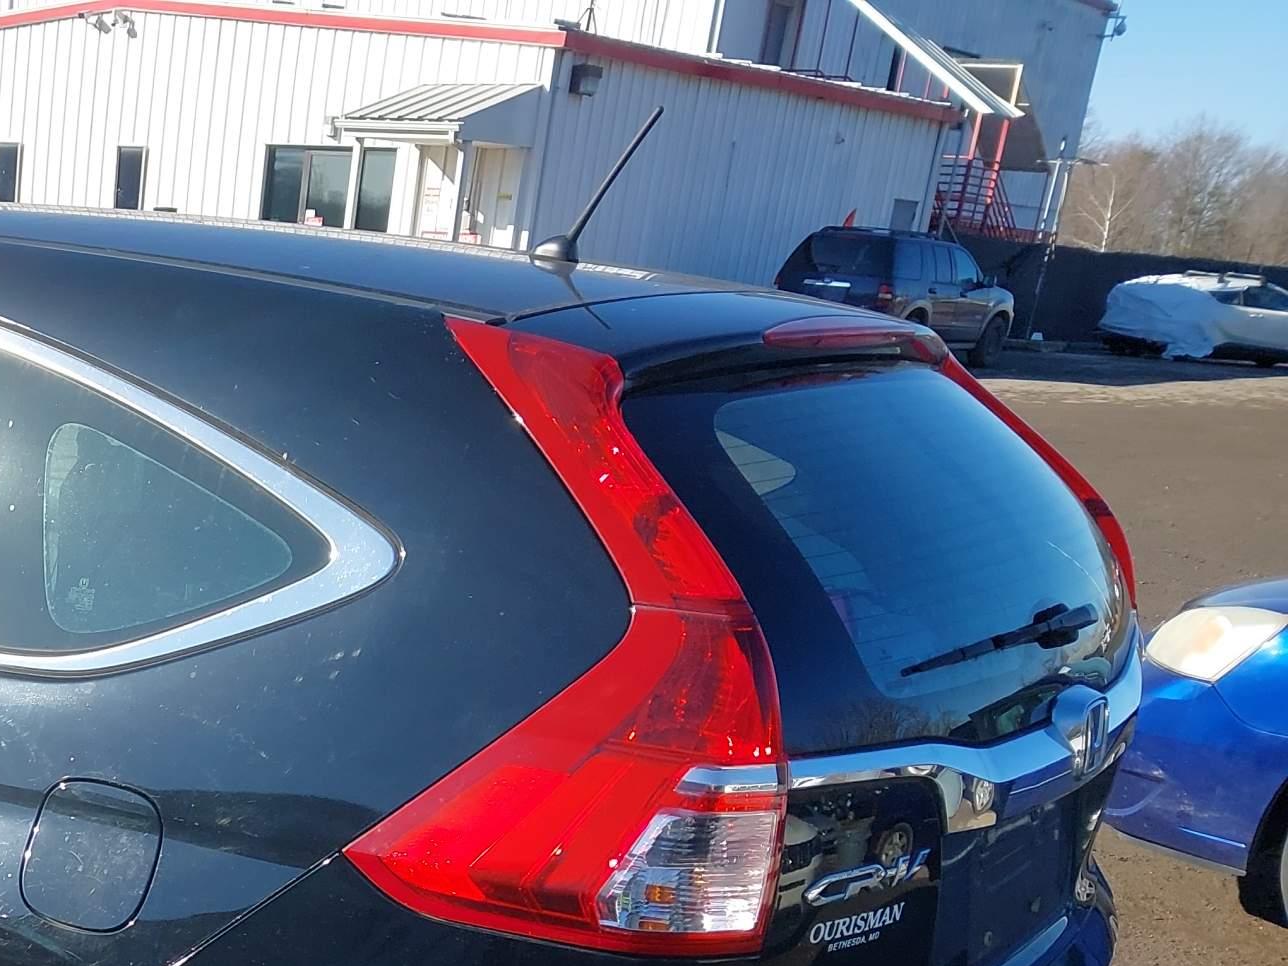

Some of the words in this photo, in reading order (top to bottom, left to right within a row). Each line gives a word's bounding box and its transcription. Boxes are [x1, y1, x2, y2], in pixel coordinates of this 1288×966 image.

[802, 848, 932, 907] CR-V
[809, 902, 905, 944] OURISMAN
[869, 931, 880, 941] MD
